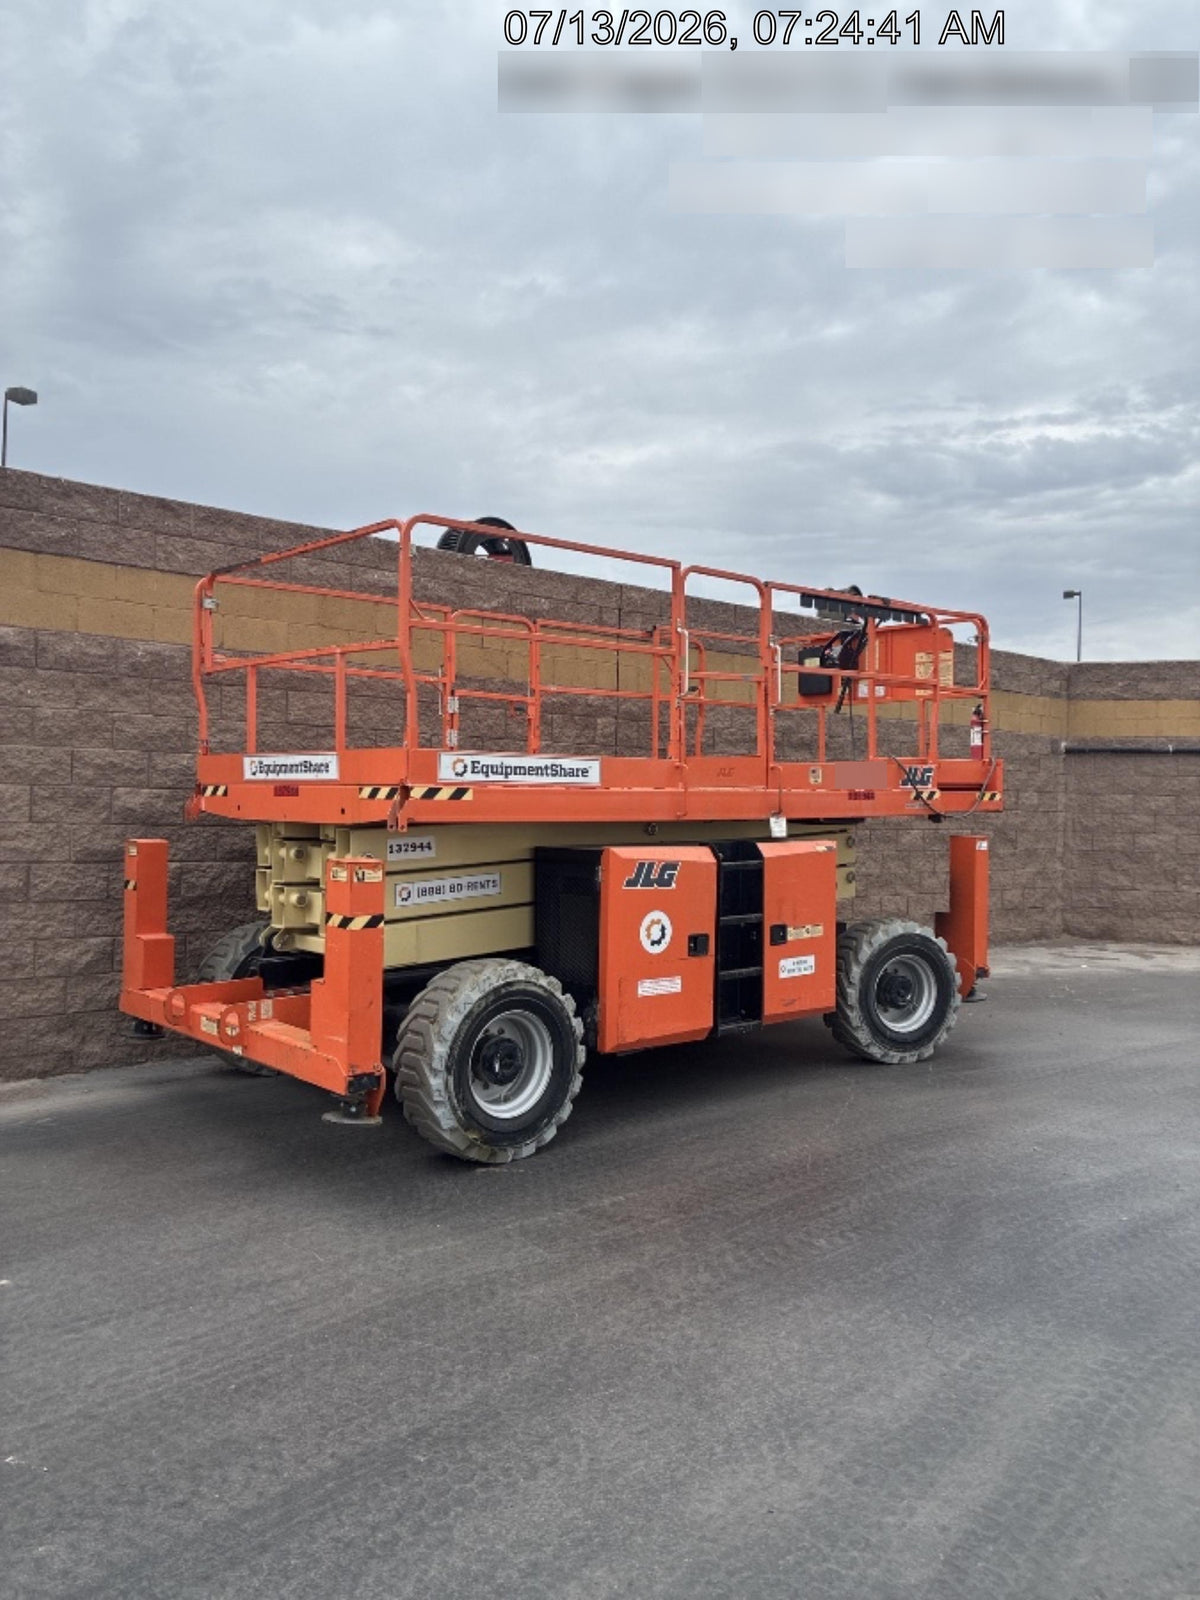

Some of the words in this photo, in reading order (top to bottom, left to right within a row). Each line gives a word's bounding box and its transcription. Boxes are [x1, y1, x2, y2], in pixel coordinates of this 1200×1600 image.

[258, 760, 330, 776] EquipmentShare
[470, 760, 590, 778] EquipmentShare
[900, 766, 934, 788] JLG
[388, 841, 433, 854] 132944
[623, 861, 680, 889] JLG
